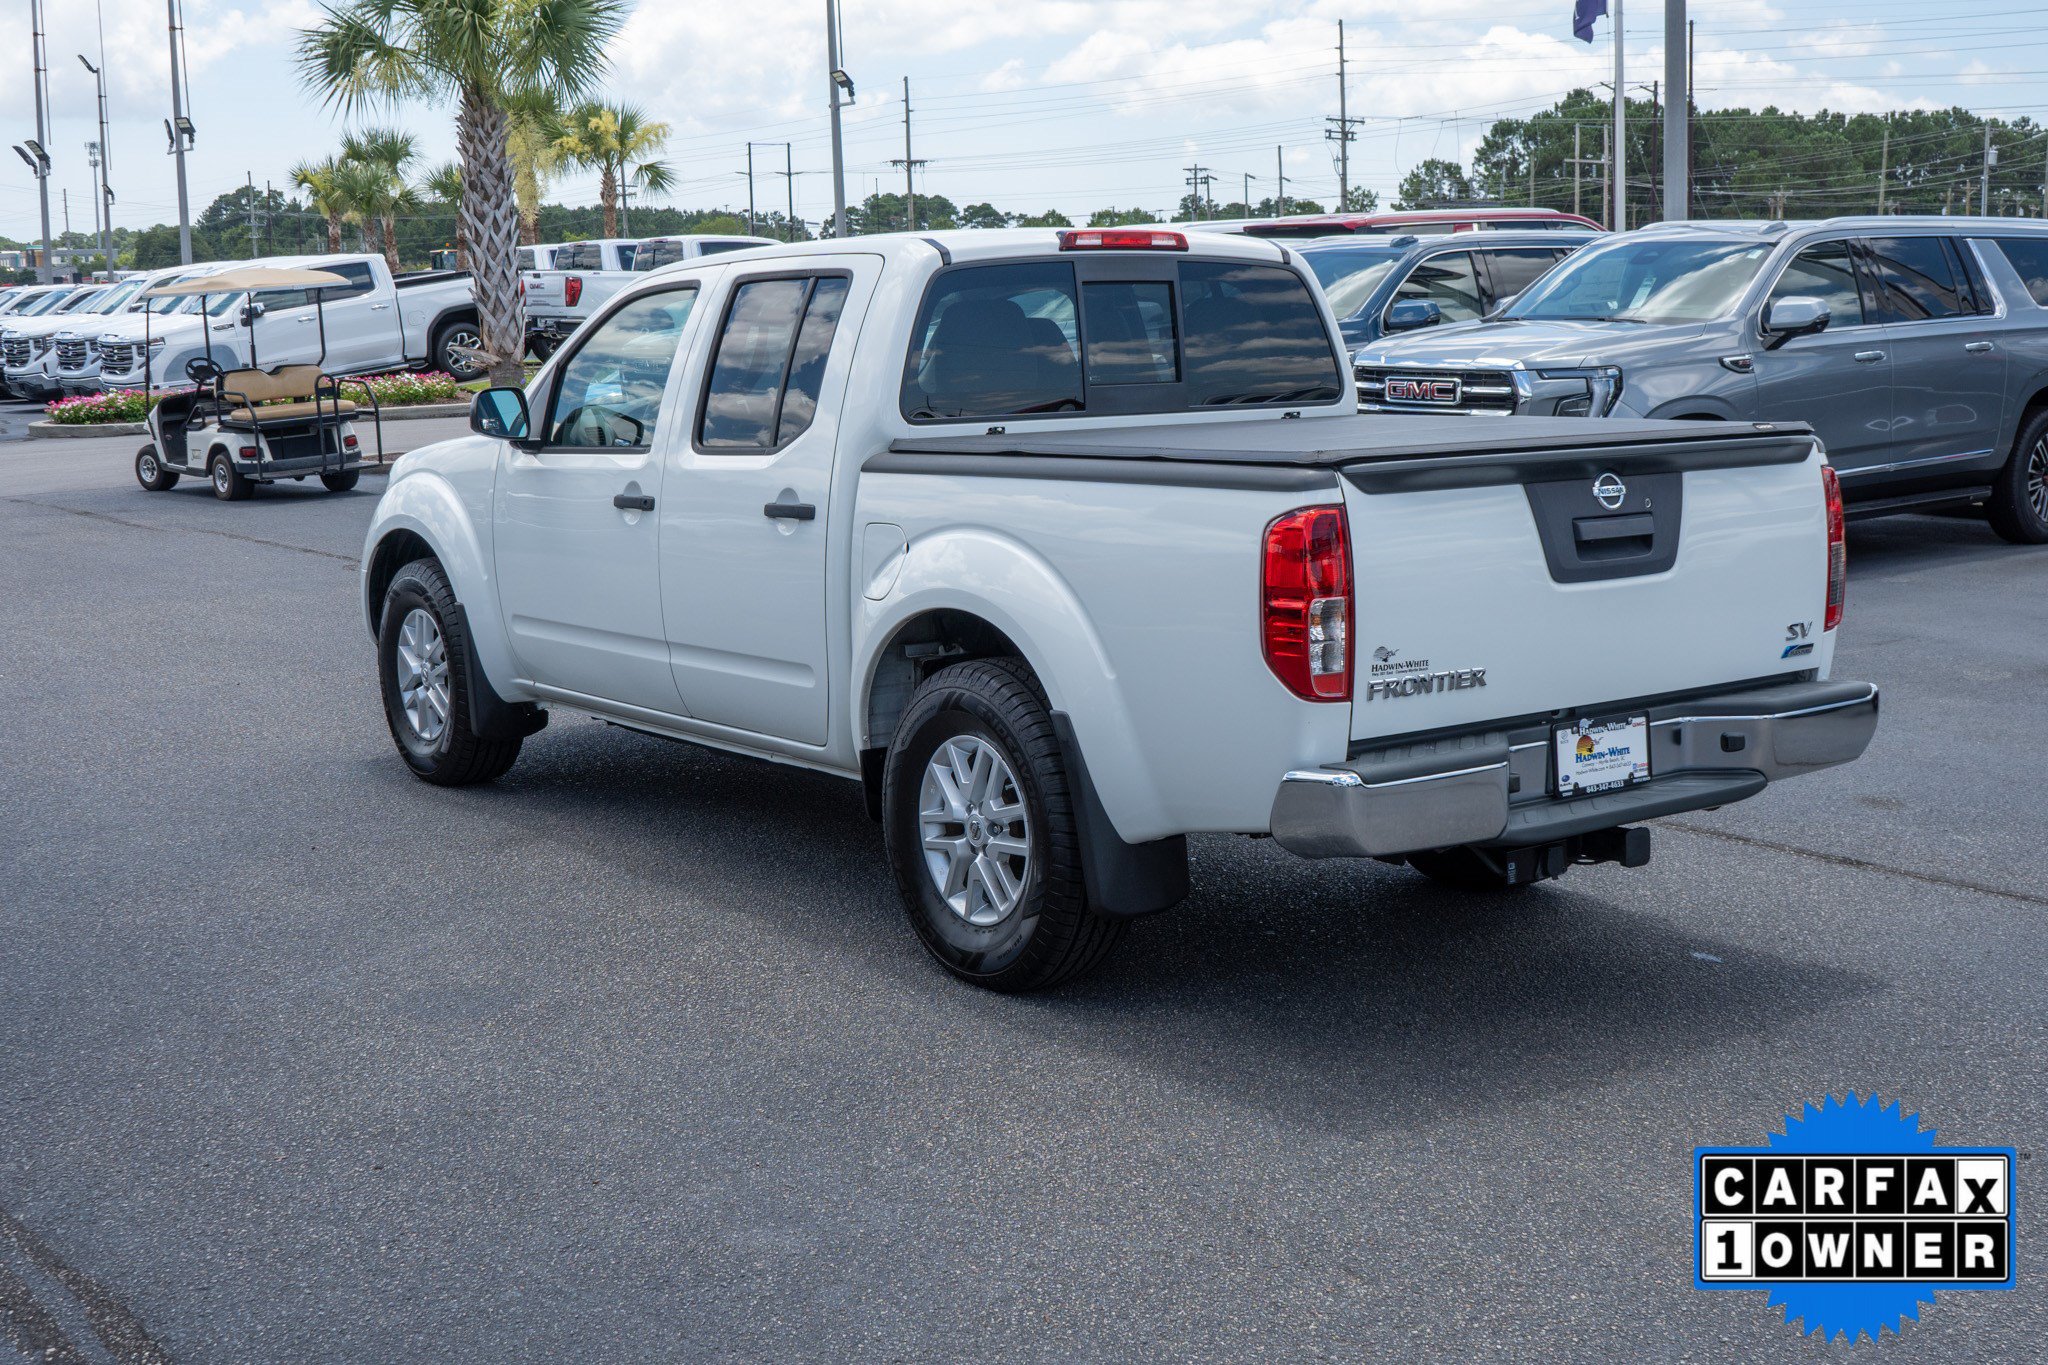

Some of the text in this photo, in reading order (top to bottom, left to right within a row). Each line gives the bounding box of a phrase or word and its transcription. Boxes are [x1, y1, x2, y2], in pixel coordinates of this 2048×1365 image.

[1387, 381, 1455, 399] GMC
[1598, 487, 1624, 495] NISSAN
[1785, 620, 1813, 641] SV
[1371, 660, 1429, 672] HADWIN-WHITE
[1367, 667, 1487, 701] FRONTIER
[1580, 722, 1626, 736] HADWIN-WHITE
[1575, 747, 1630, 763] HADWIN-WHITE
[1586, 780, 1624, 793] 843-347-4633
